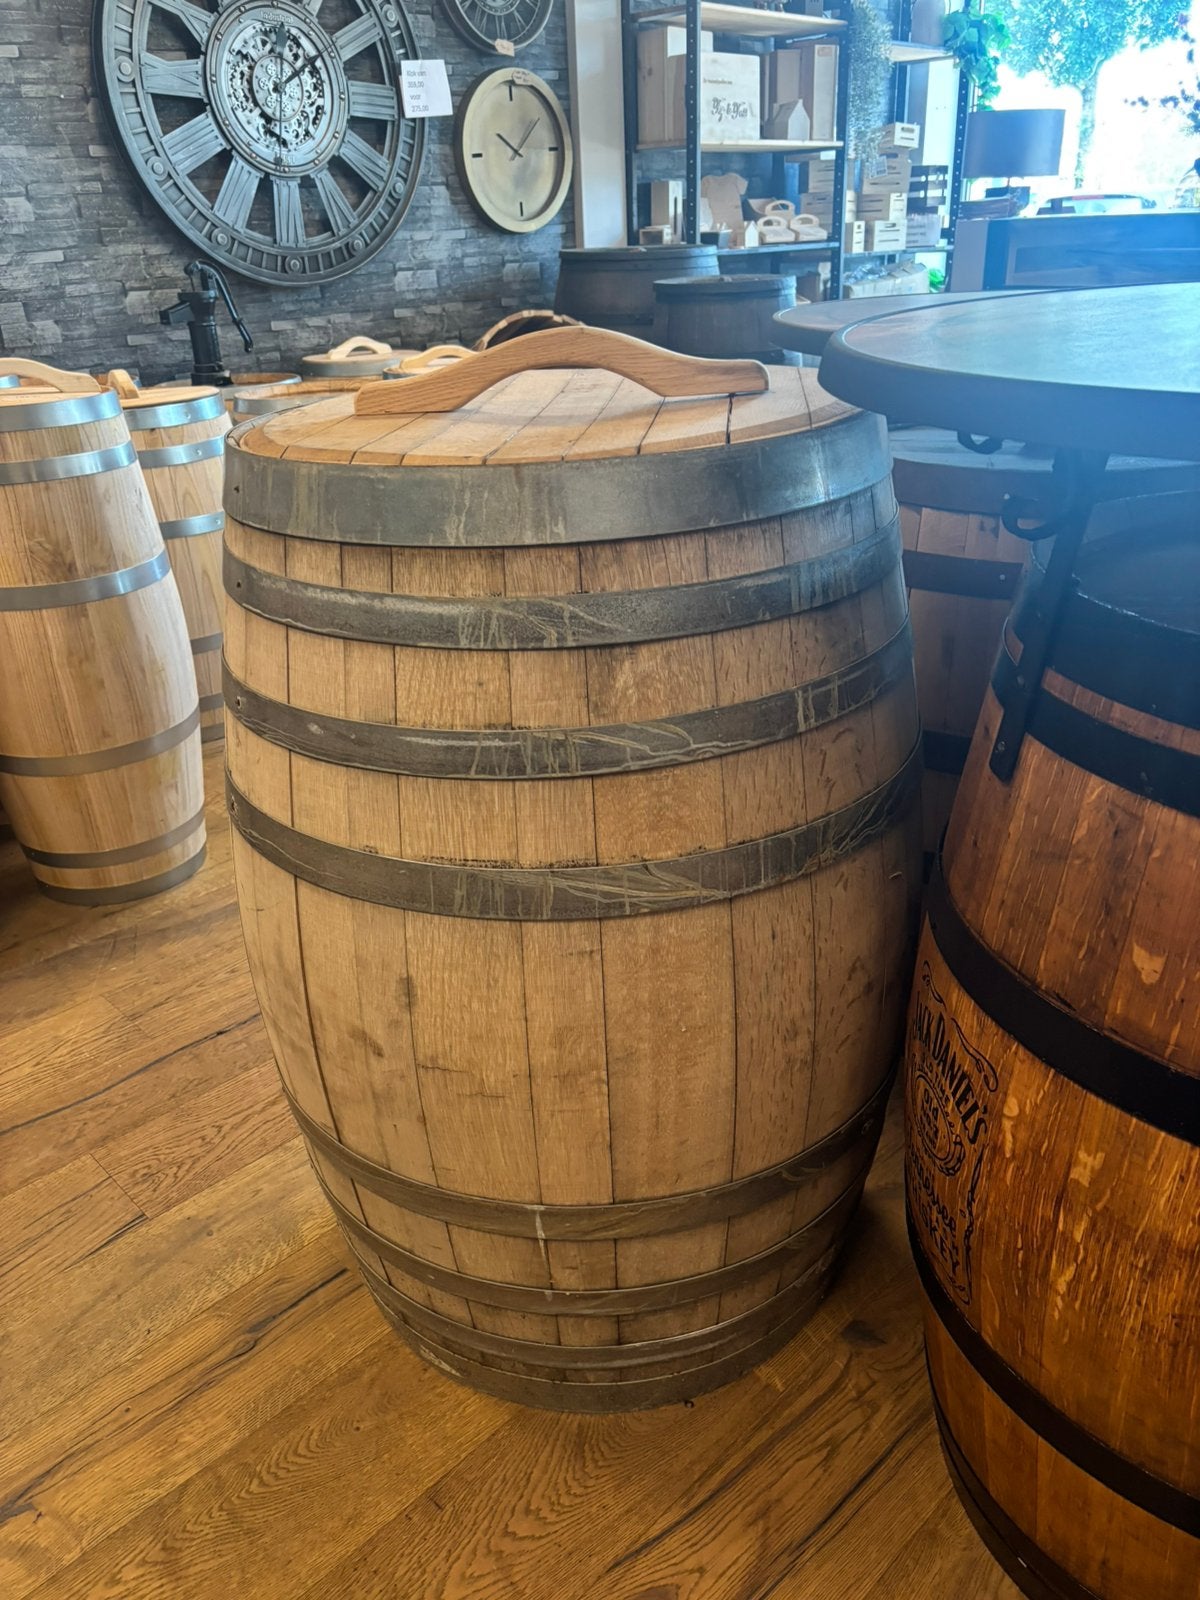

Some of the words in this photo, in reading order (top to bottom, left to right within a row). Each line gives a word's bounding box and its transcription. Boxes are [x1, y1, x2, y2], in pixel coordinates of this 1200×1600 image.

[260, 10, 294, 23] Industrial
[913, 990, 934, 1053] JACK
[932, 1010, 988, 1145] DANIEL'S
